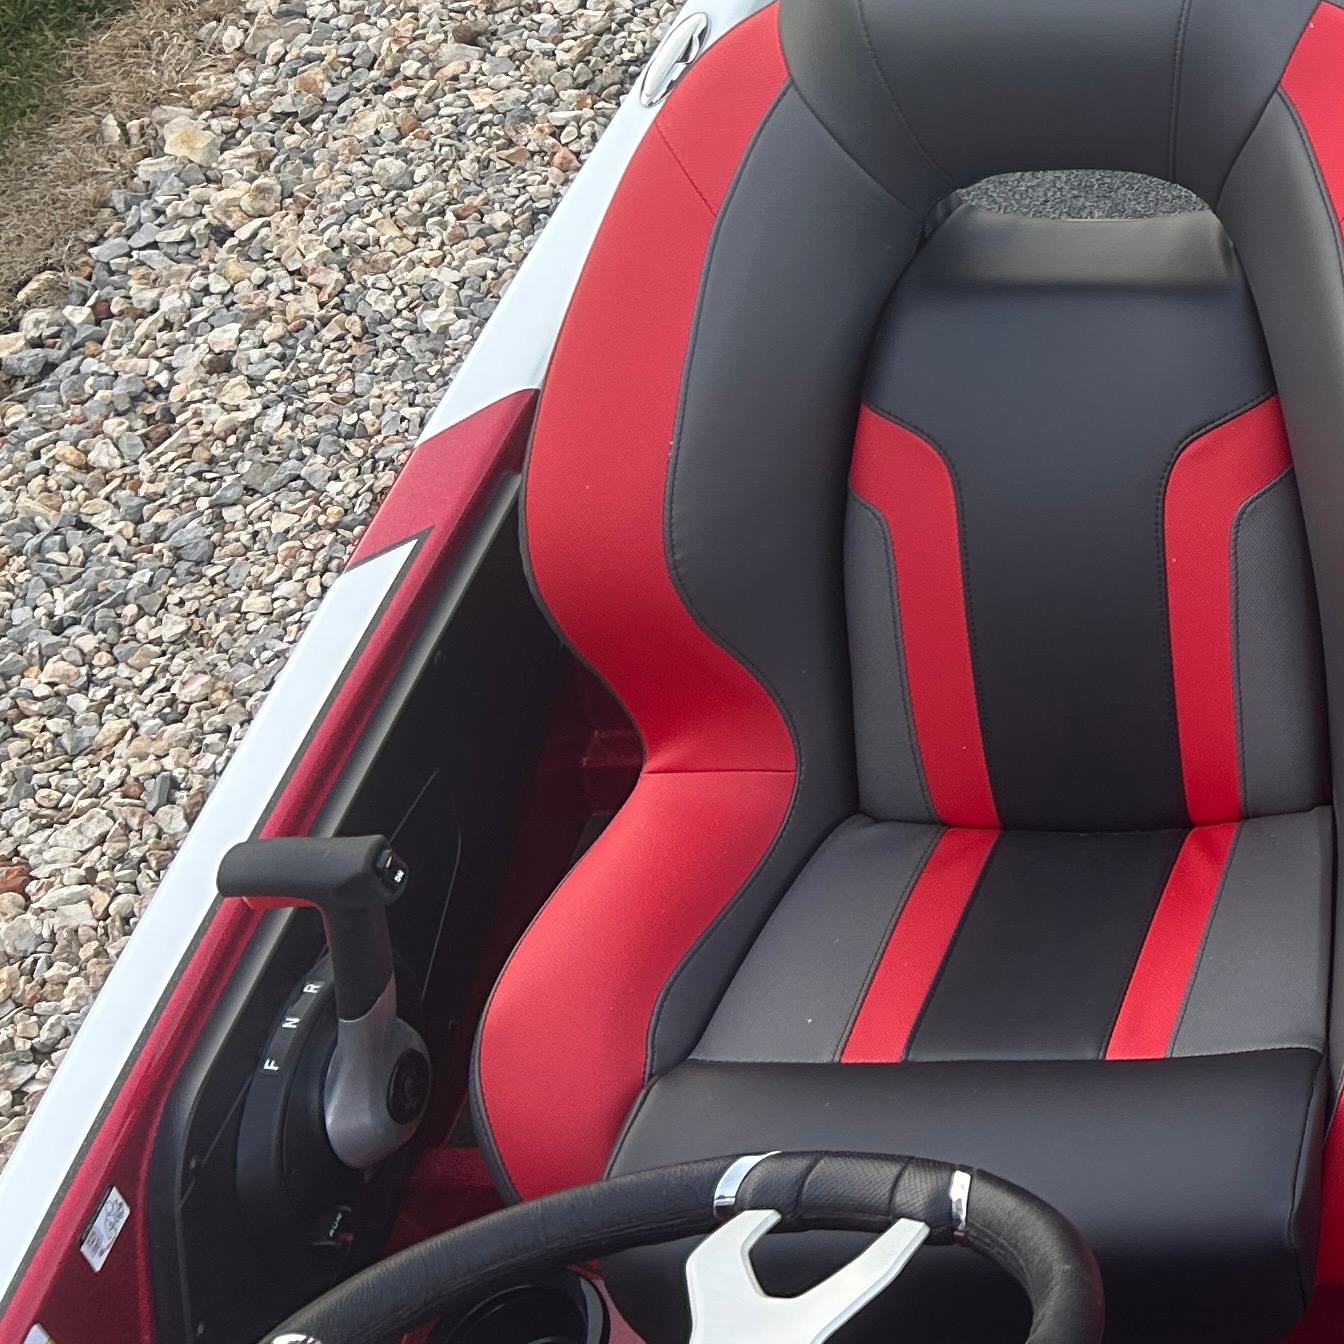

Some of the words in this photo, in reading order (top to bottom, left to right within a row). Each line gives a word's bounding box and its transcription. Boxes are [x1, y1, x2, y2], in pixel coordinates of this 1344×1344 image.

[303, 983, 322, 994] R
[282, 1017, 300, 1029] N
[263, 1058, 279, 1071] F
